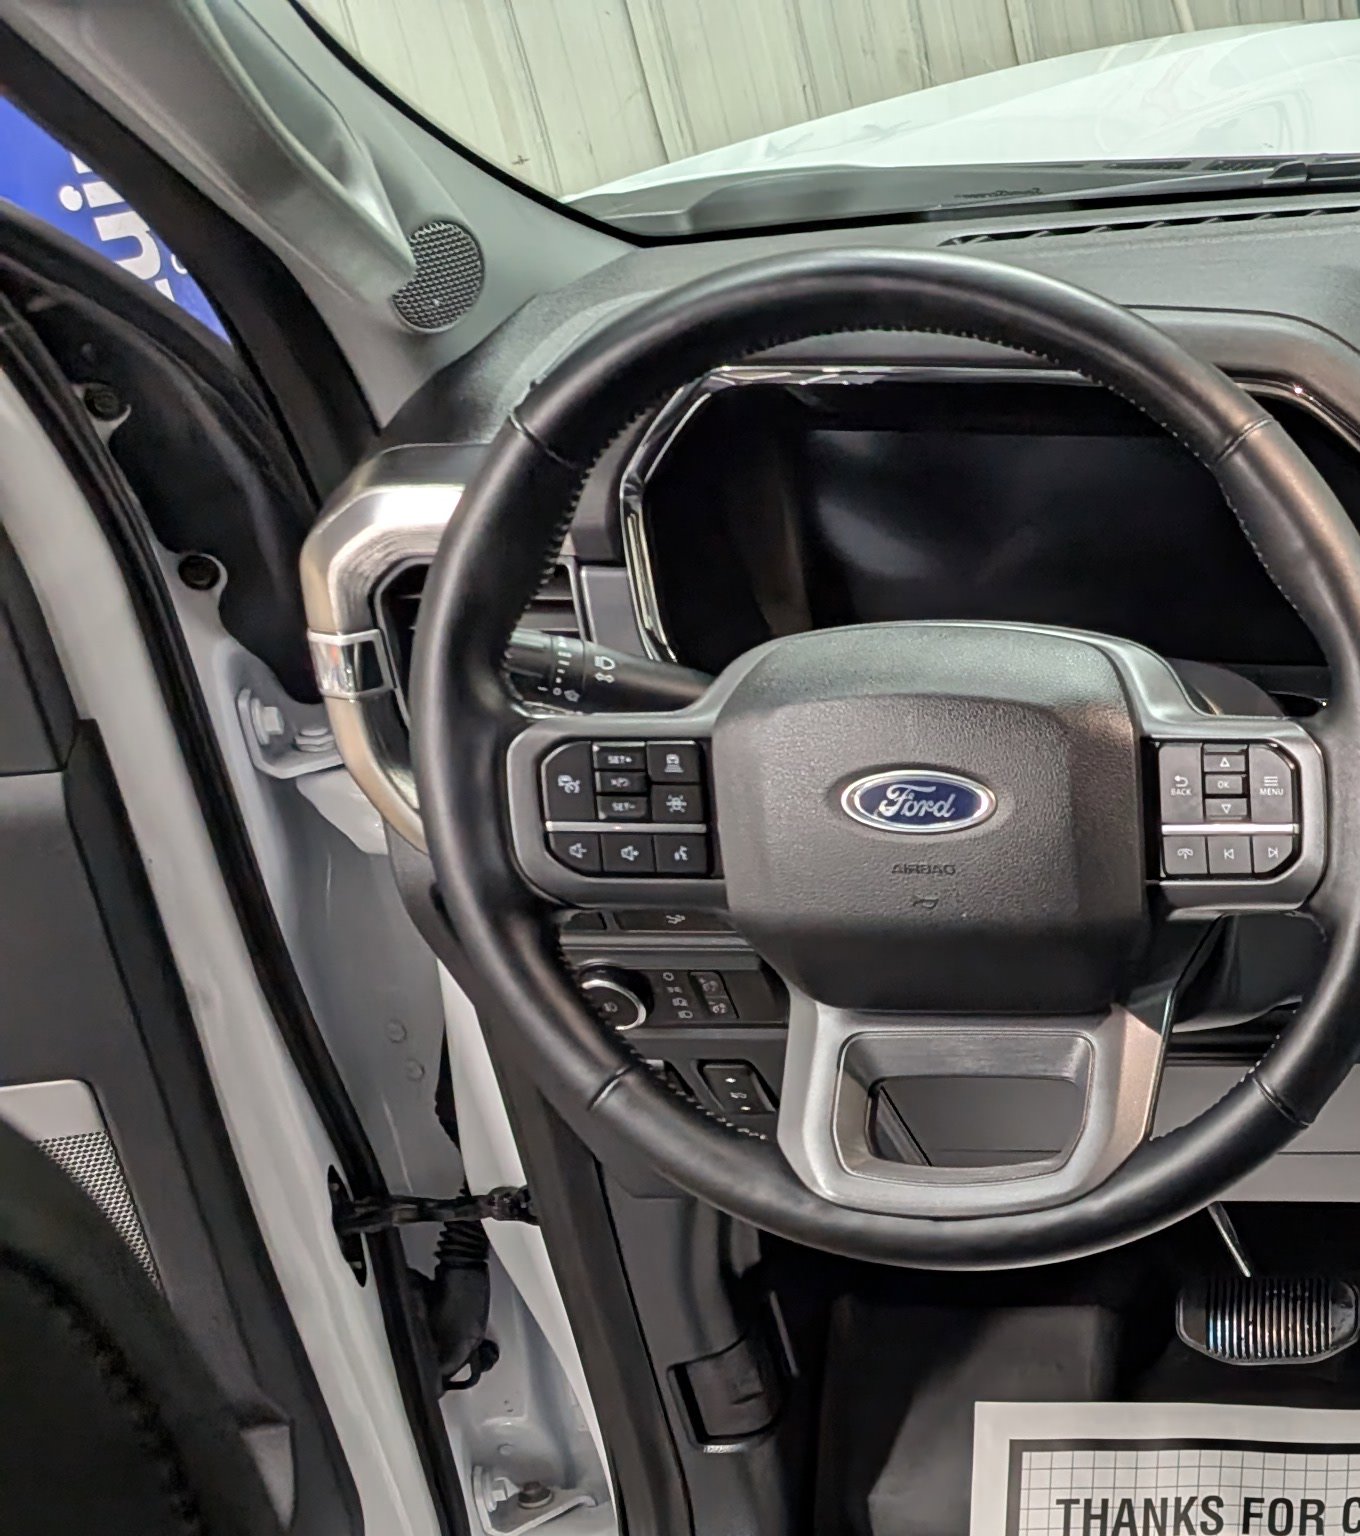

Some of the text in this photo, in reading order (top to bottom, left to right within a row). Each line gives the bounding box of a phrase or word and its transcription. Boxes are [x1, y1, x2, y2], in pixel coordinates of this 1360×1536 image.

[1217, 780, 1230, 789] OK
[1170, 788, 1192, 796] BACK
[1259, 788, 1284, 796] MENU
[873, 783, 956, 818] Ford
[891, 863, 956, 876] AIRBAG
[1241, 1496, 1325, 1536] FOR
